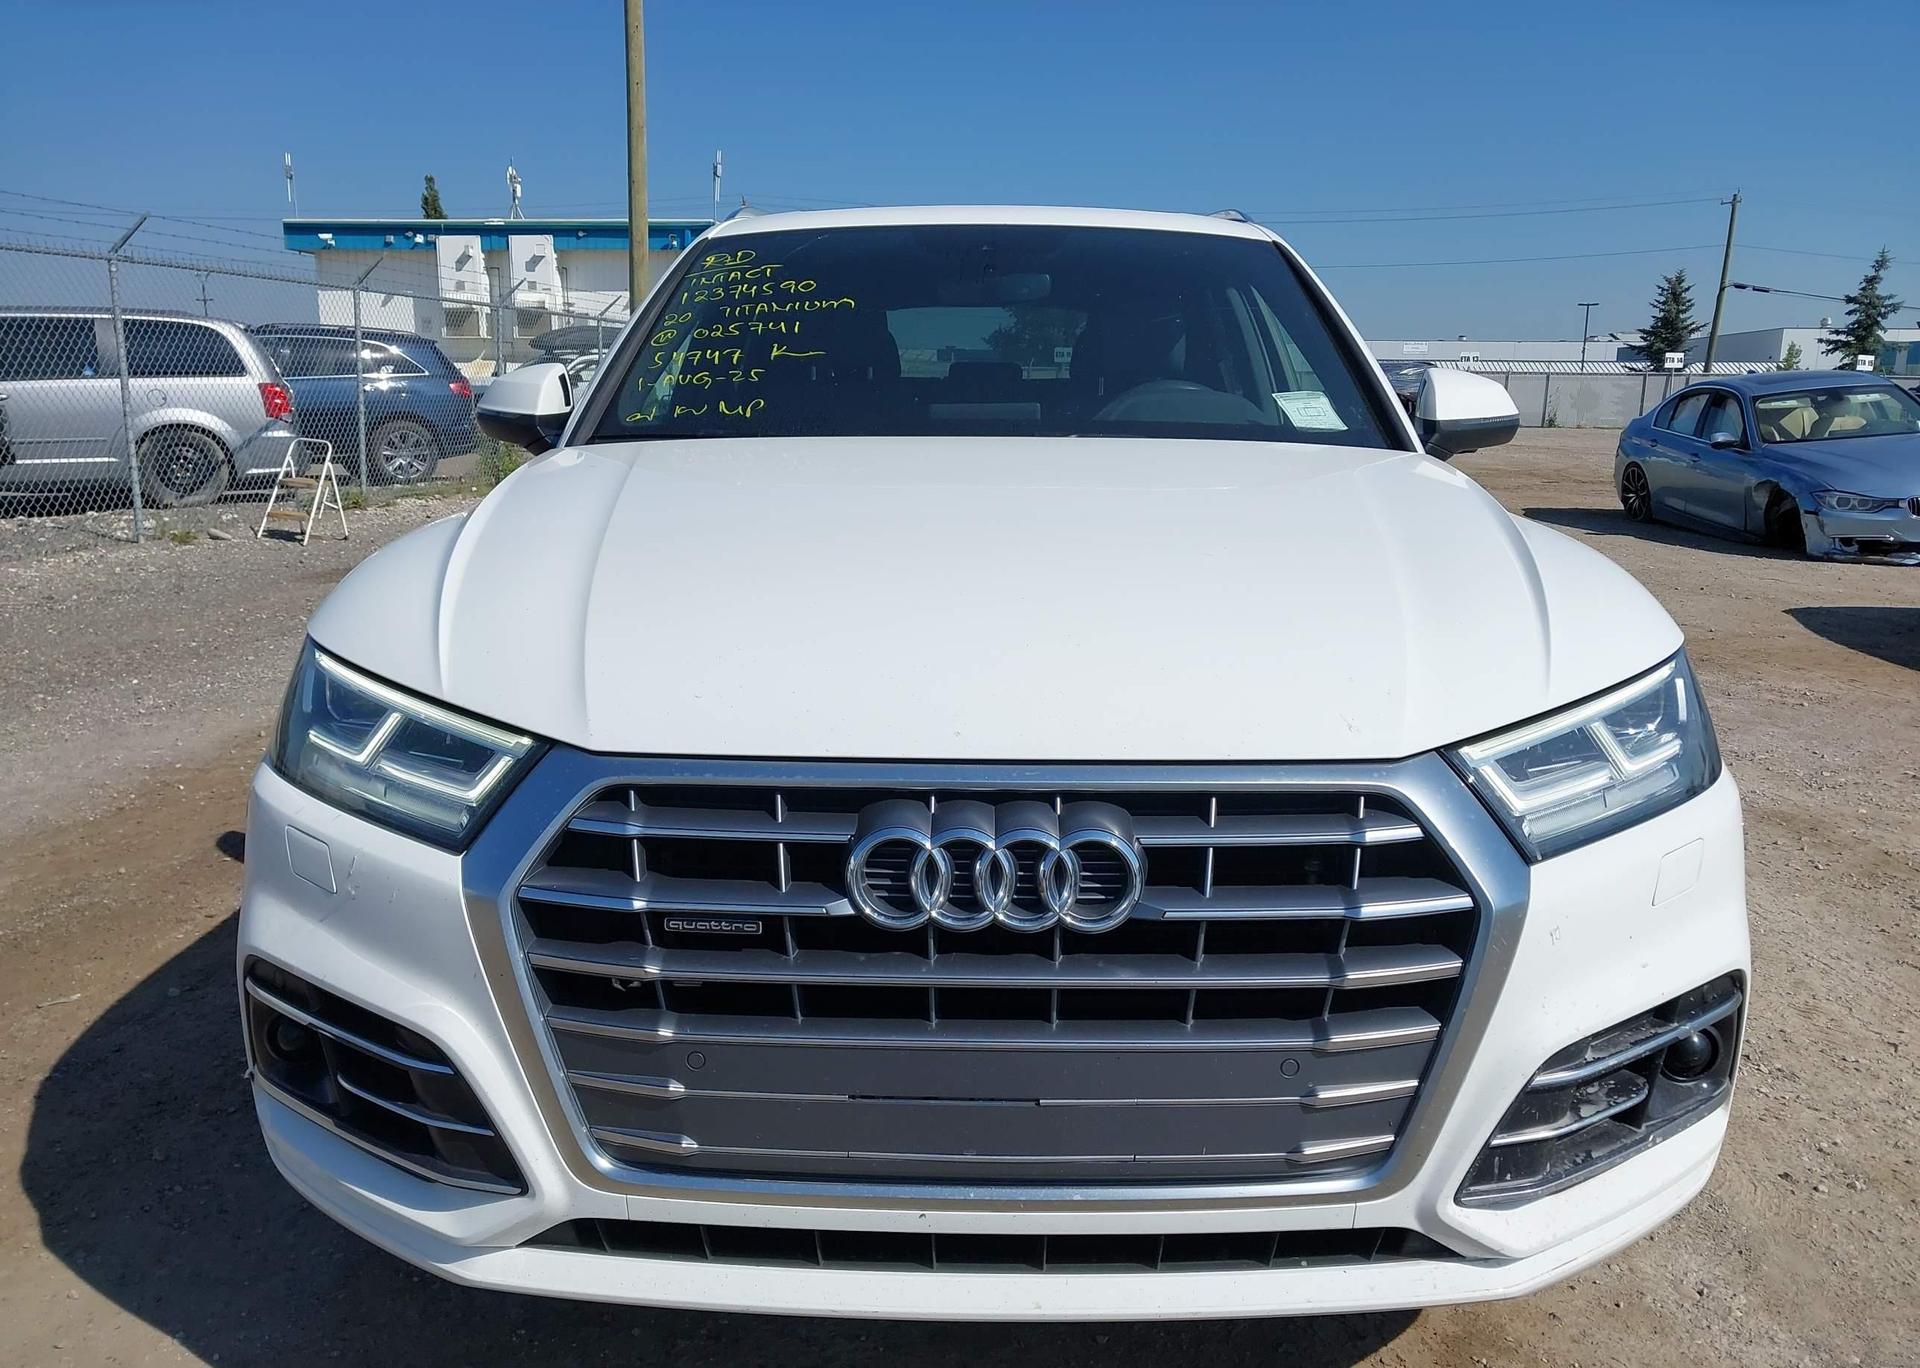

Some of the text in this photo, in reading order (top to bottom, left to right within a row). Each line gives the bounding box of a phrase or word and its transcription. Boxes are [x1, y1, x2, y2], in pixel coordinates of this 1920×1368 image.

[690, 264, 784, 287] INTACT
[681, 280, 817, 305] 12374590
[664, 312, 692, 327] 20
[694, 321, 800, 339] 025741
[648, 348, 745, 369] 54747
[669, 920, 758, 932] quattro
